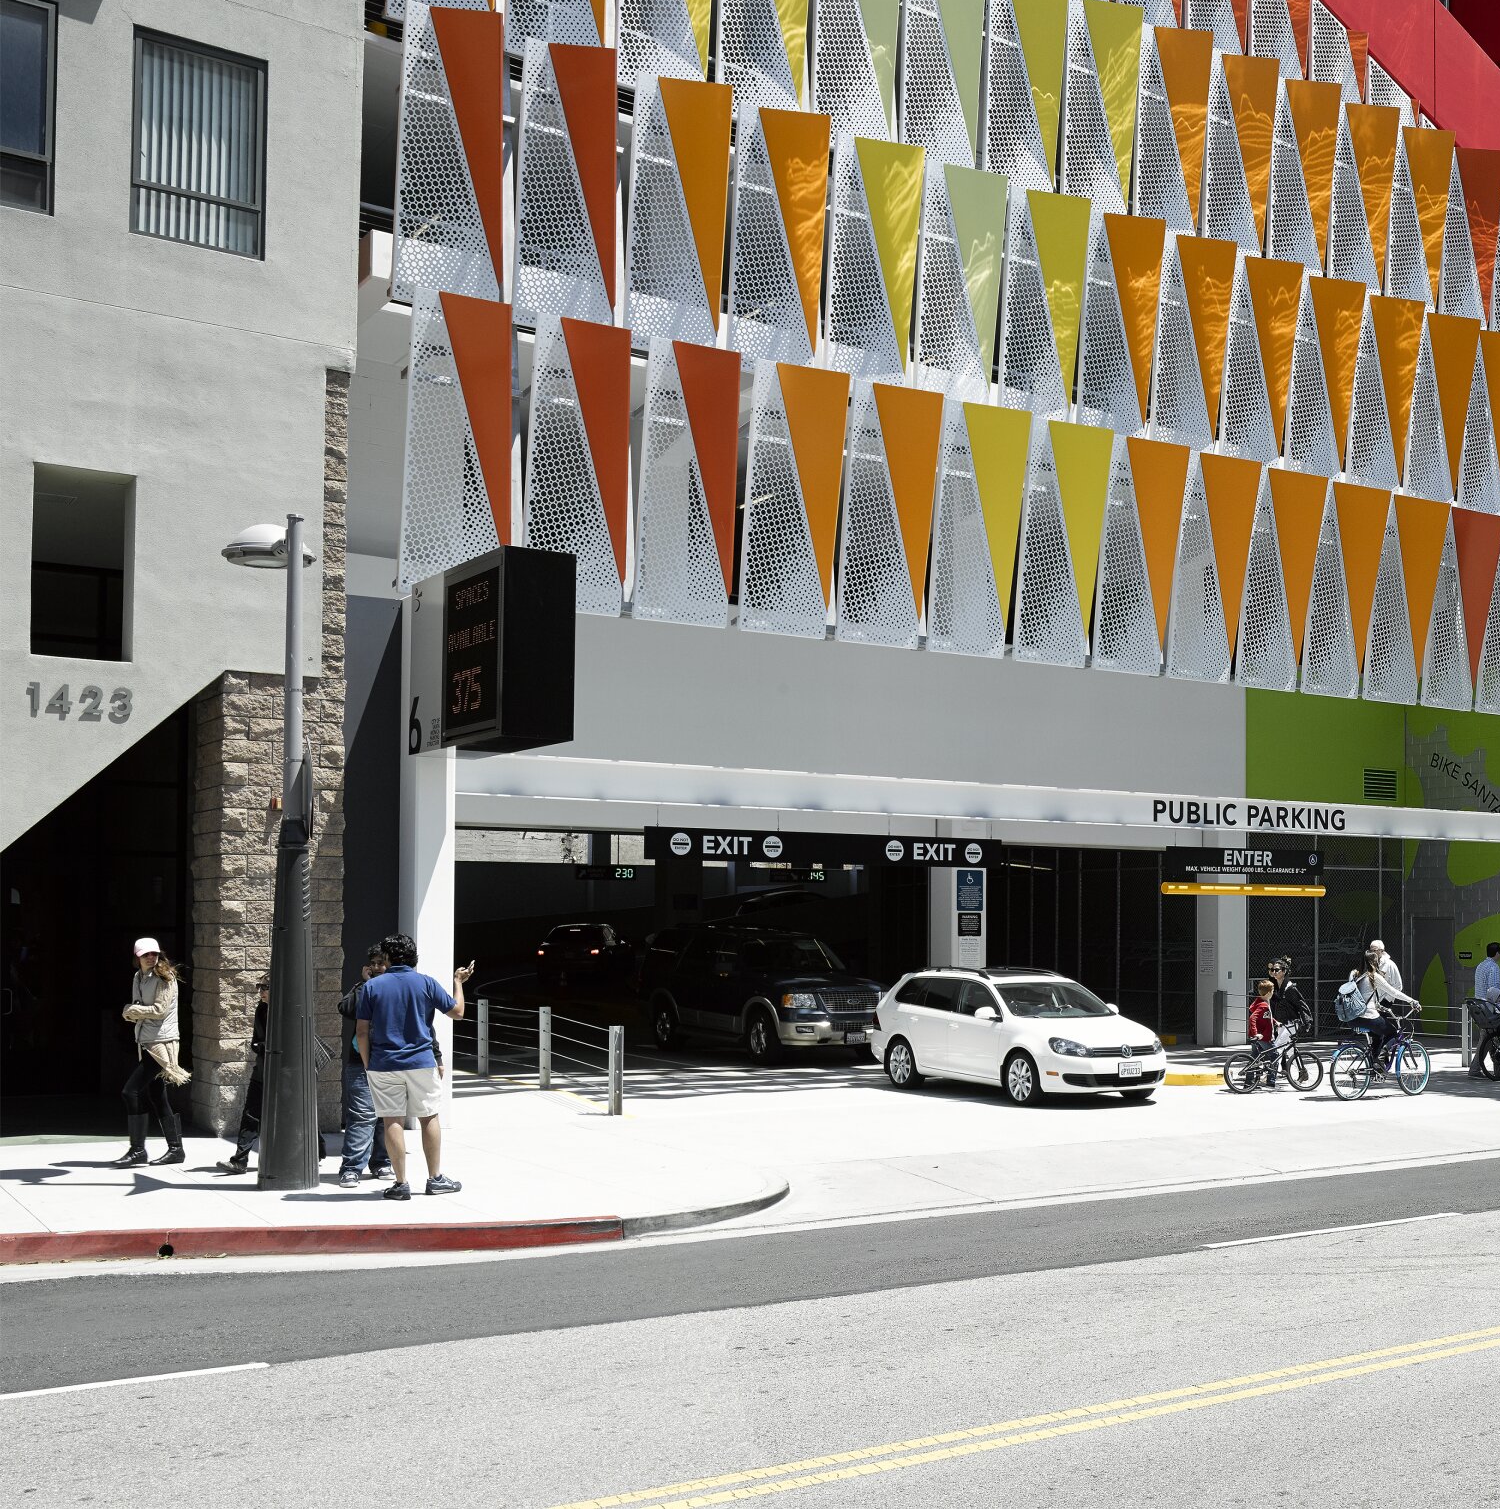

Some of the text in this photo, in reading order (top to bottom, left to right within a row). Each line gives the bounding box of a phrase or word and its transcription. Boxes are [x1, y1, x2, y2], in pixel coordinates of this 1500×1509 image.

[455, 580, 489, 610] SPACES
[448, 619, 496, 653] AVAILABLE
[26, 682, 133, 722] 1423
[452, 666, 482, 714] 375
[408, 695, 421, 755] 6
[1430, 753, 1462, 780] BIKE
[1153, 799, 1346, 831] PUBLIC PARKING
[702, 835, 753, 855] EXIT
[913, 843, 956, 861] EXIT
[1223, 849, 1273, 866] ENTER
[615, 868, 634, 878] 230
